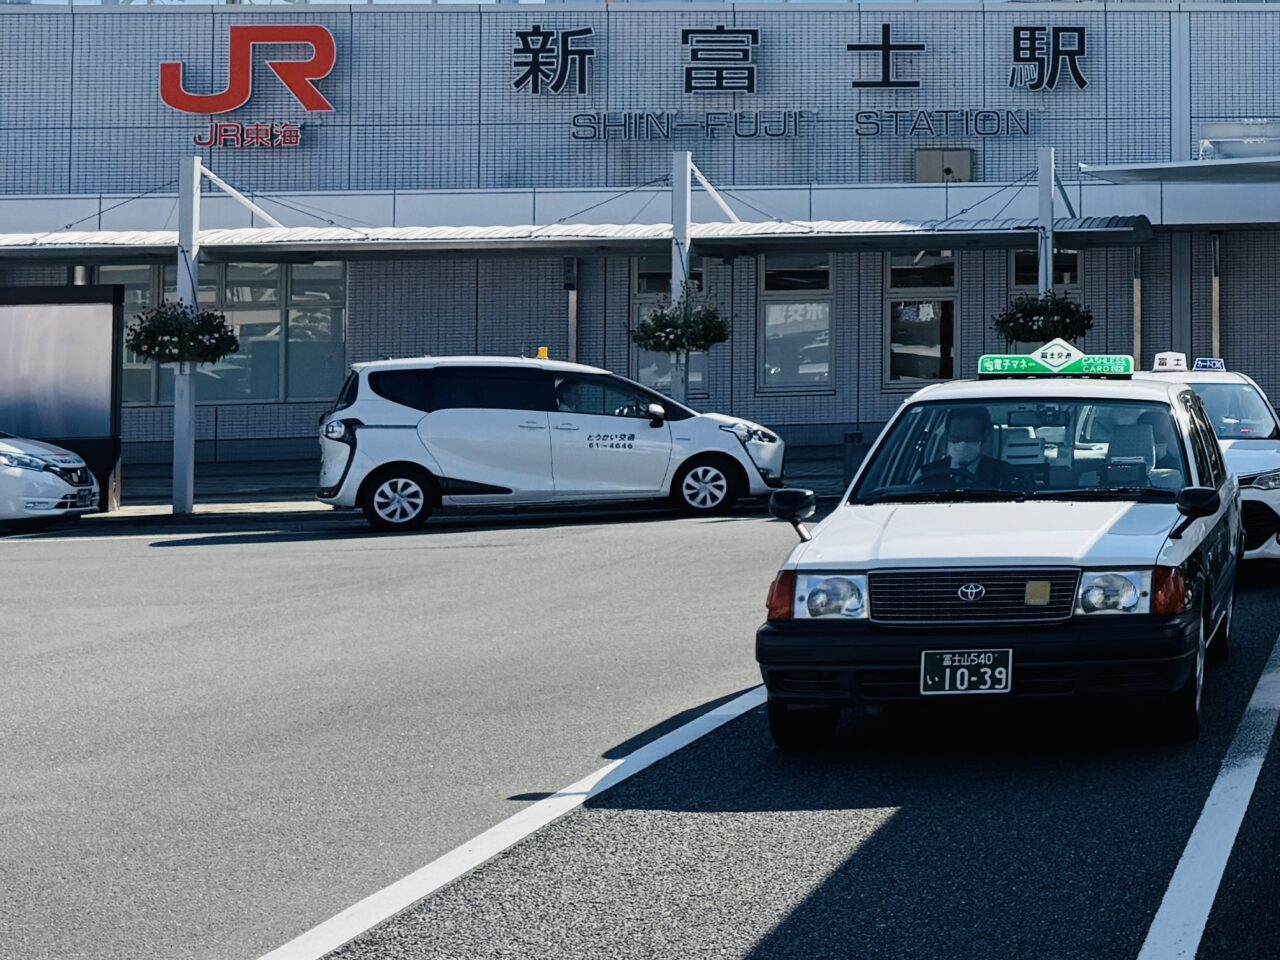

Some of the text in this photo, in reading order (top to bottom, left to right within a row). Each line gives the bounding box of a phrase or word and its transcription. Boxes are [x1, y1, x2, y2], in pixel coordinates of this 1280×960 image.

[159, 23, 337, 115] JR
[511, 22, 1090, 96] 新富士駅
[193, 122, 302, 148] JR東海
[571, 108, 1032, 141] SHIN-FUJI STATION
[1081, 357, 1126, 365] CASHLESS
[1158, 357, 1183, 367] 富士
[943, 653, 993, 666] 富士山540
[926, 666, 1007, 691] い 10-39
